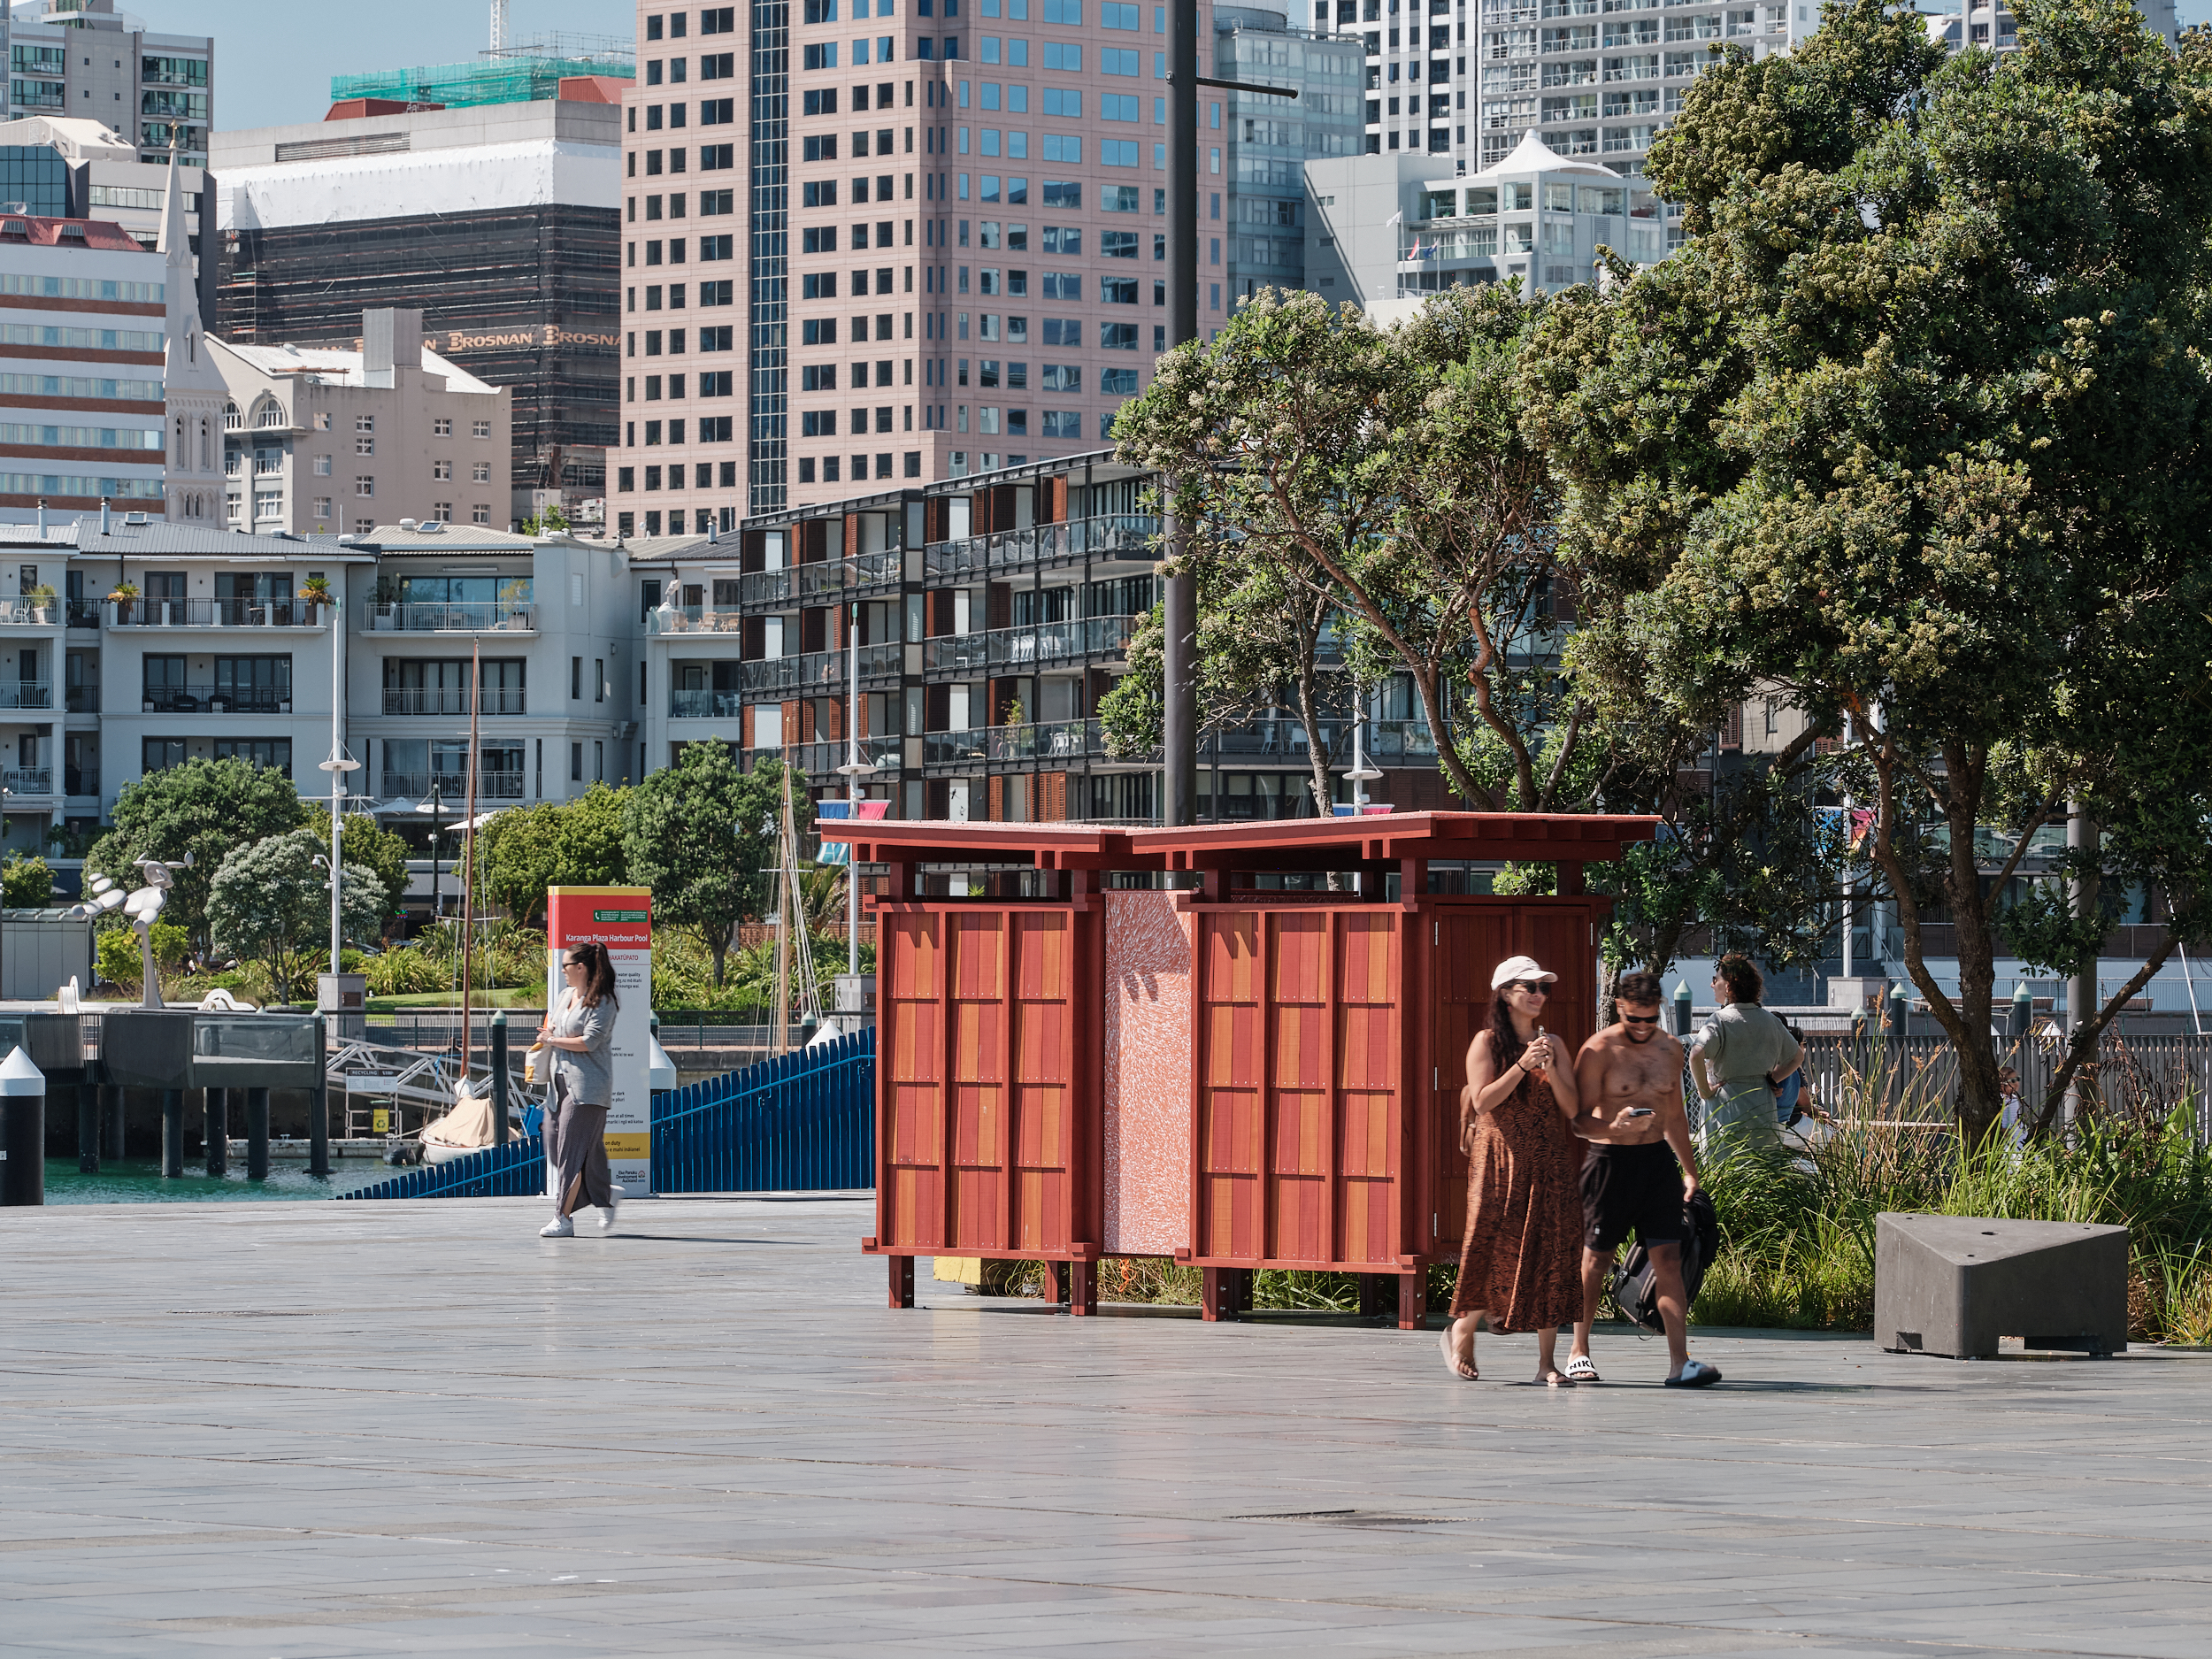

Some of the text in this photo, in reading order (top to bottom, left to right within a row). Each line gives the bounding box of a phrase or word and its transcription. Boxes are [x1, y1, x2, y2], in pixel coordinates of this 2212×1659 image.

[448, 332, 532, 351] BROSNAN
[542, 325, 620, 346] BROSNA
[565, 934, 591, 943] Karanga
